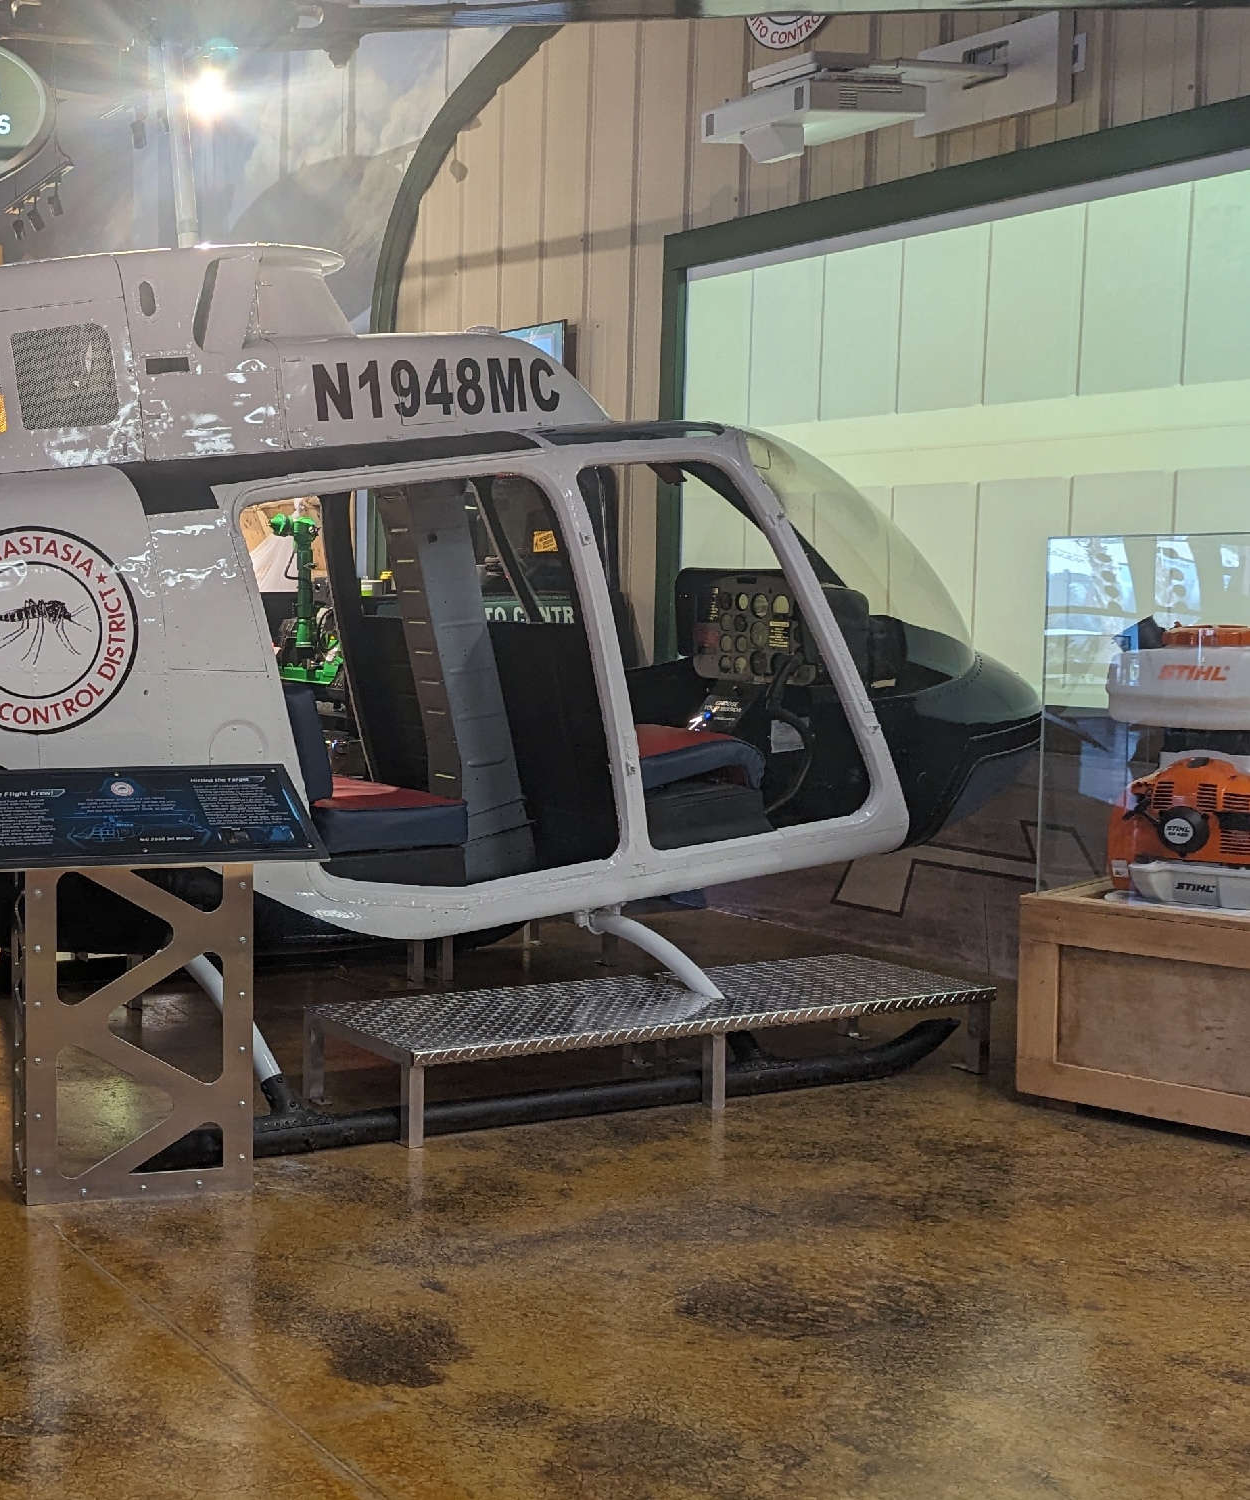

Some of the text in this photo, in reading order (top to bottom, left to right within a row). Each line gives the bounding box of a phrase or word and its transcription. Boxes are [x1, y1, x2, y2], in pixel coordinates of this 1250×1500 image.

[312, 358, 560, 421] N1948MC
[513, 606, 575, 624] CNTR
[96, 587, 126, 682] DISTRICT
[1158, 665, 1228, 681] STIHL
[1175, 882, 1217, 893] STIHL
